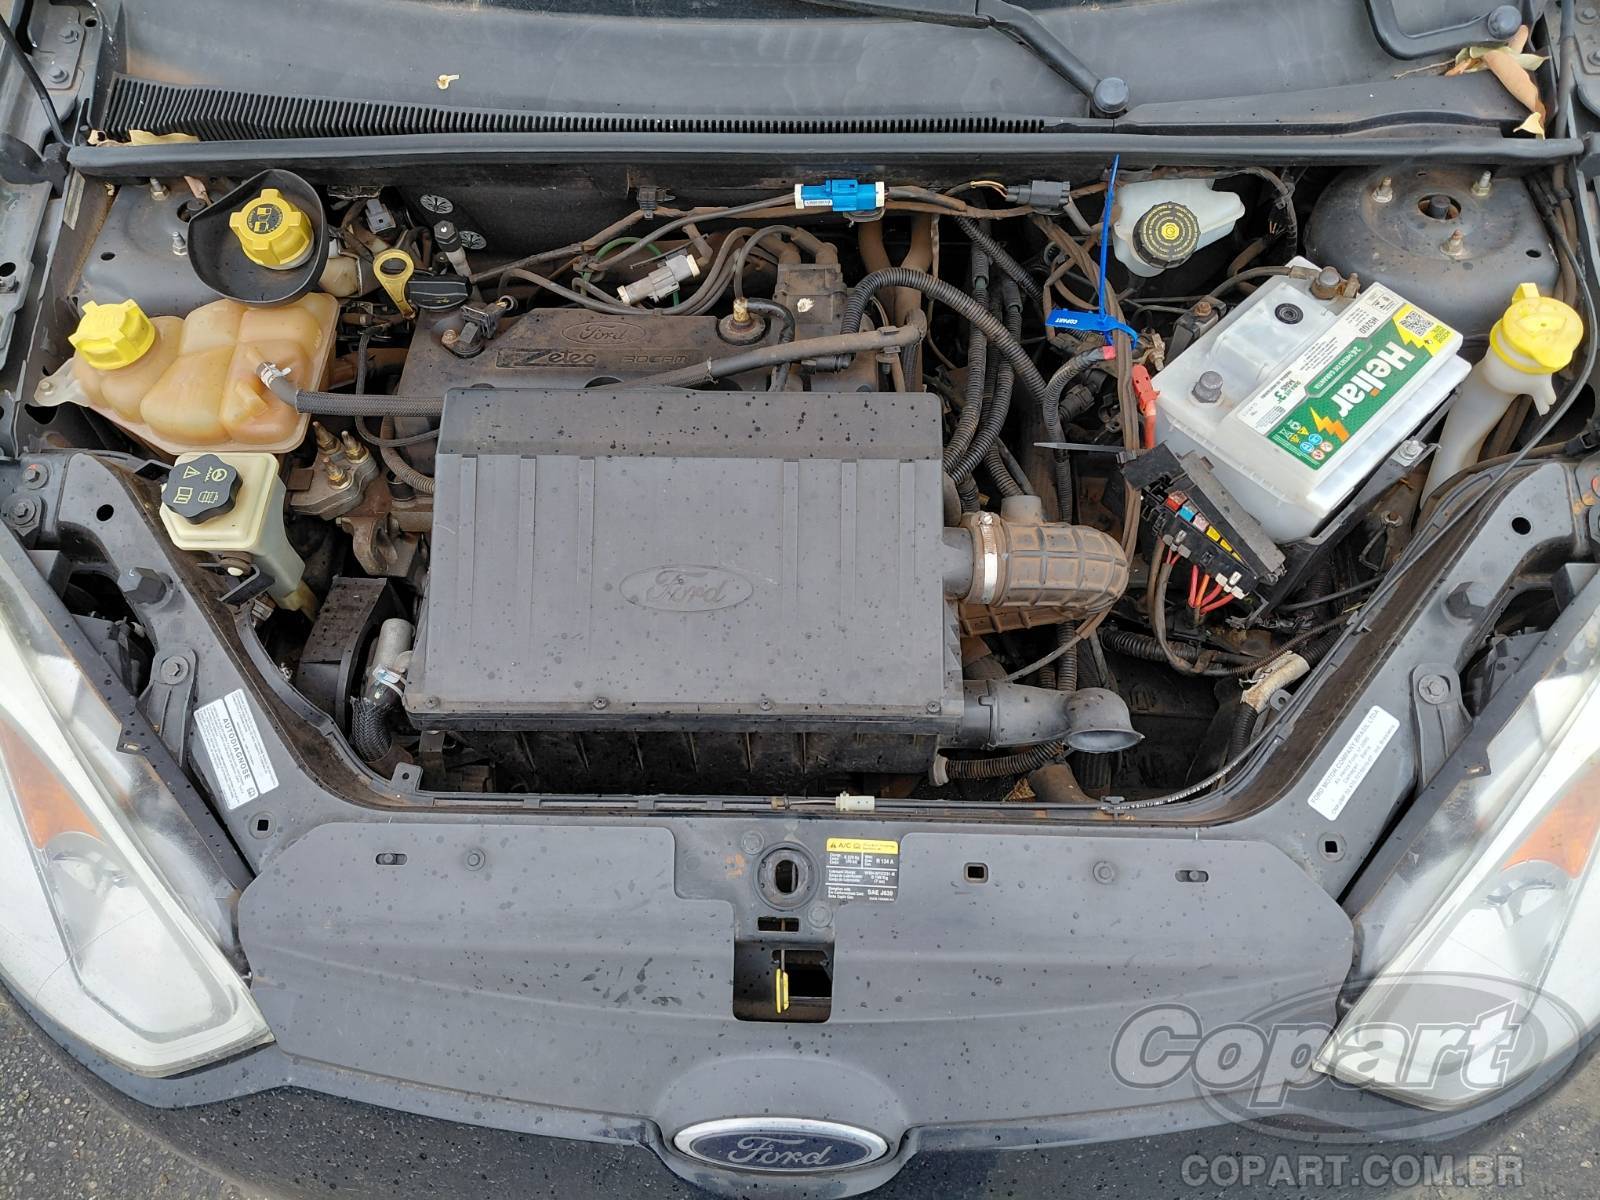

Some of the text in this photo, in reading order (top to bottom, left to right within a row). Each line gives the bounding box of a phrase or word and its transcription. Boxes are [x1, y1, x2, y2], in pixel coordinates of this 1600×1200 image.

[578, 325, 628, 340] Ford
[515, 348, 597, 367] Zetec
[1314, 371, 1335, 388] GARANTIA
[1331, 342, 1415, 418] Heliar
[647, 570, 728, 603] Ford
[222, 718, 250, 780] AUTODIAGNOSE
[1311, 788, 1324, 803] FORD
[1322, 768, 1338, 788] MOTOR
[1336, 742, 1356, 768] COMPANY
[728, 1136, 832, 1165] Ford
